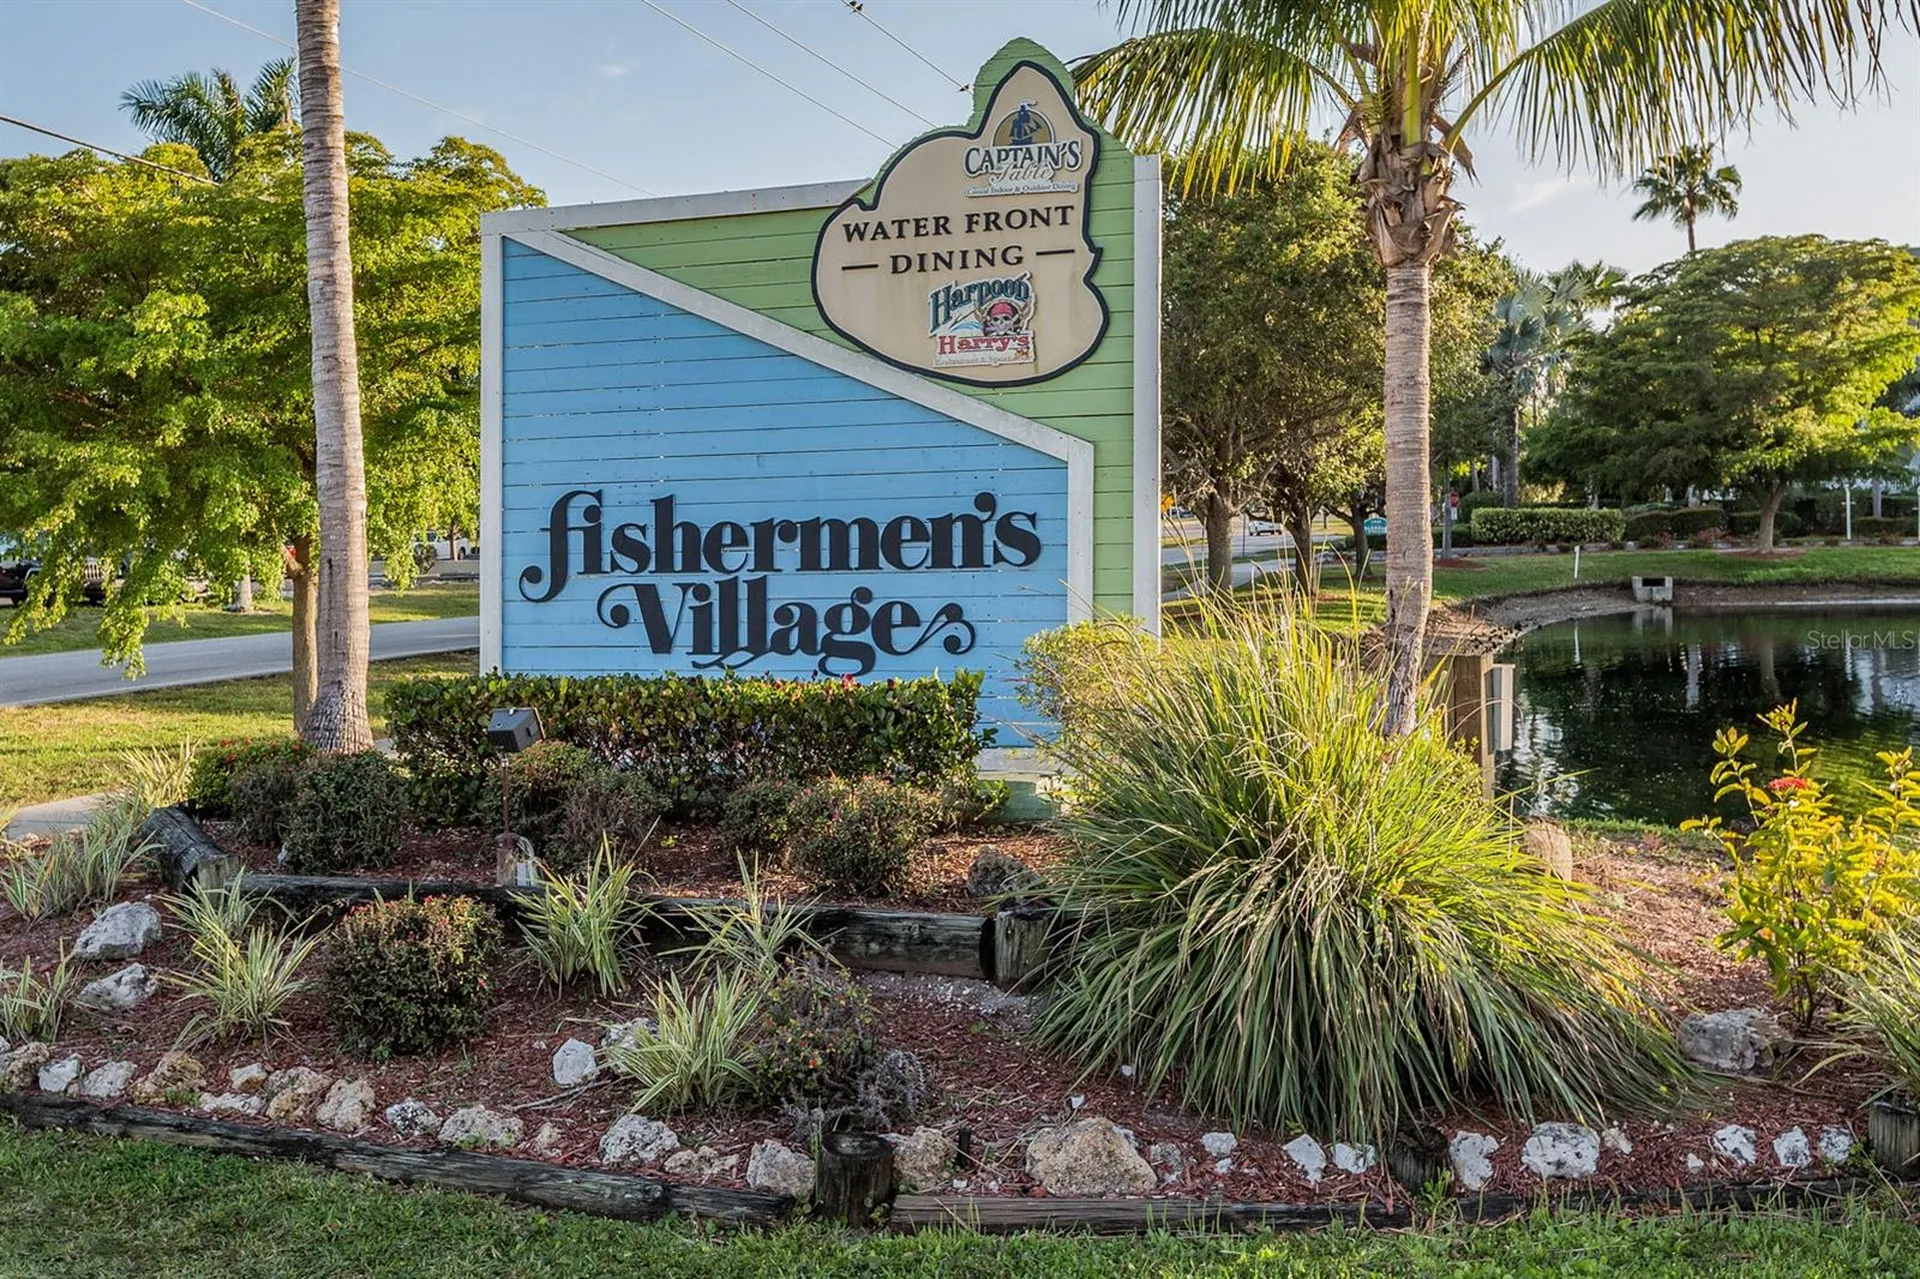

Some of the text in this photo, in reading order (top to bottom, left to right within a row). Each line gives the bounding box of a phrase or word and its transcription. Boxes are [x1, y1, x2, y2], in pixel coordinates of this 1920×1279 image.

[964, 139, 1080, 175] CAPTAIN'S
[990, 161, 1055, 182] Table
[843, 205, 1074, 242] WATER FRONT
[890, 245, 1023, 274] DINING
[930, 275, 1030, 333] Harpoon
[938, 334, 1030, 355] Harry's
[518, 489, 1041, 603] fishermen's
[596, 574, 976, 676] Village
